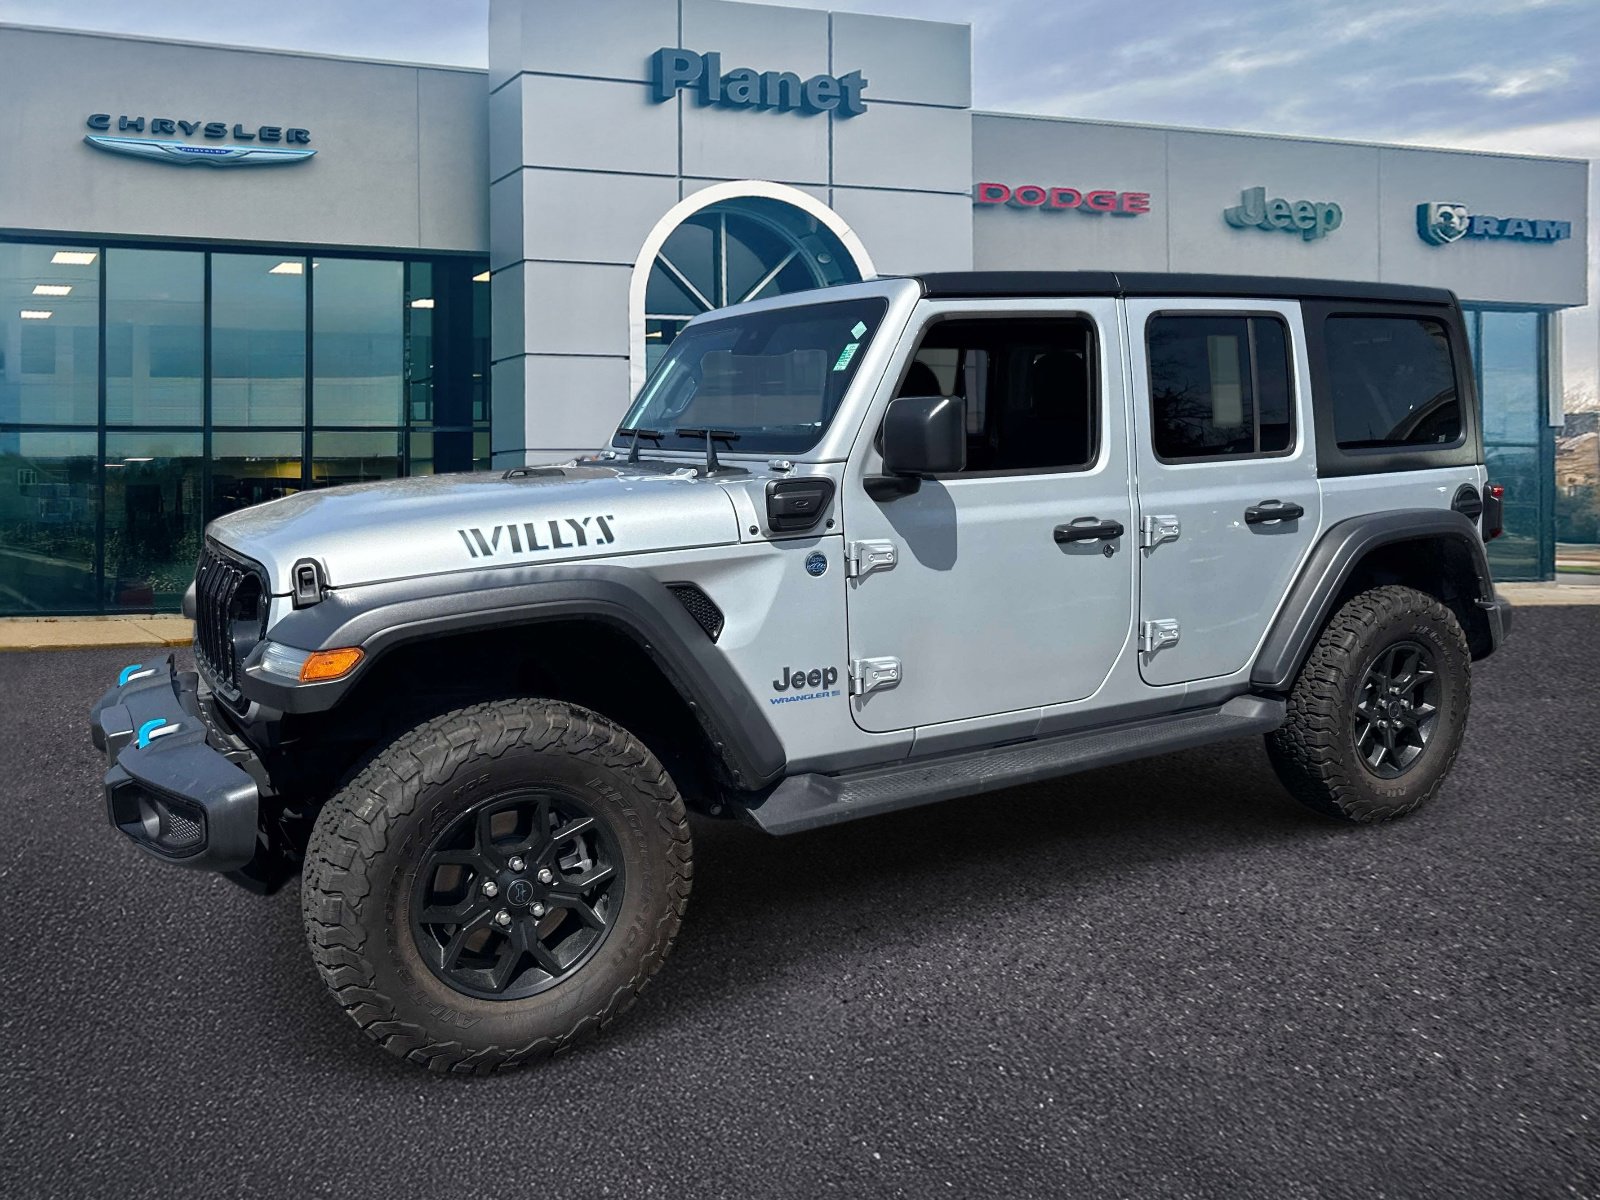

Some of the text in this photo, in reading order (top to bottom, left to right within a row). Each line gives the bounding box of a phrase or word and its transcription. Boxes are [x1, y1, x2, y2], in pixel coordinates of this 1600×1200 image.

[653, 47, 868, 117] Planet
[87, 113, 311, 144] CHRYSLER
[975, 182, 1150, 216] DODGE
[1224, 186, 1343, 241] Jeep
[1473, 215, 1571, 243] RAM
[457, 515, 615, 558] WILLYS
[773, 665, 838, 691] Jeep
[770, 691, 830, 704] WRANGLER
